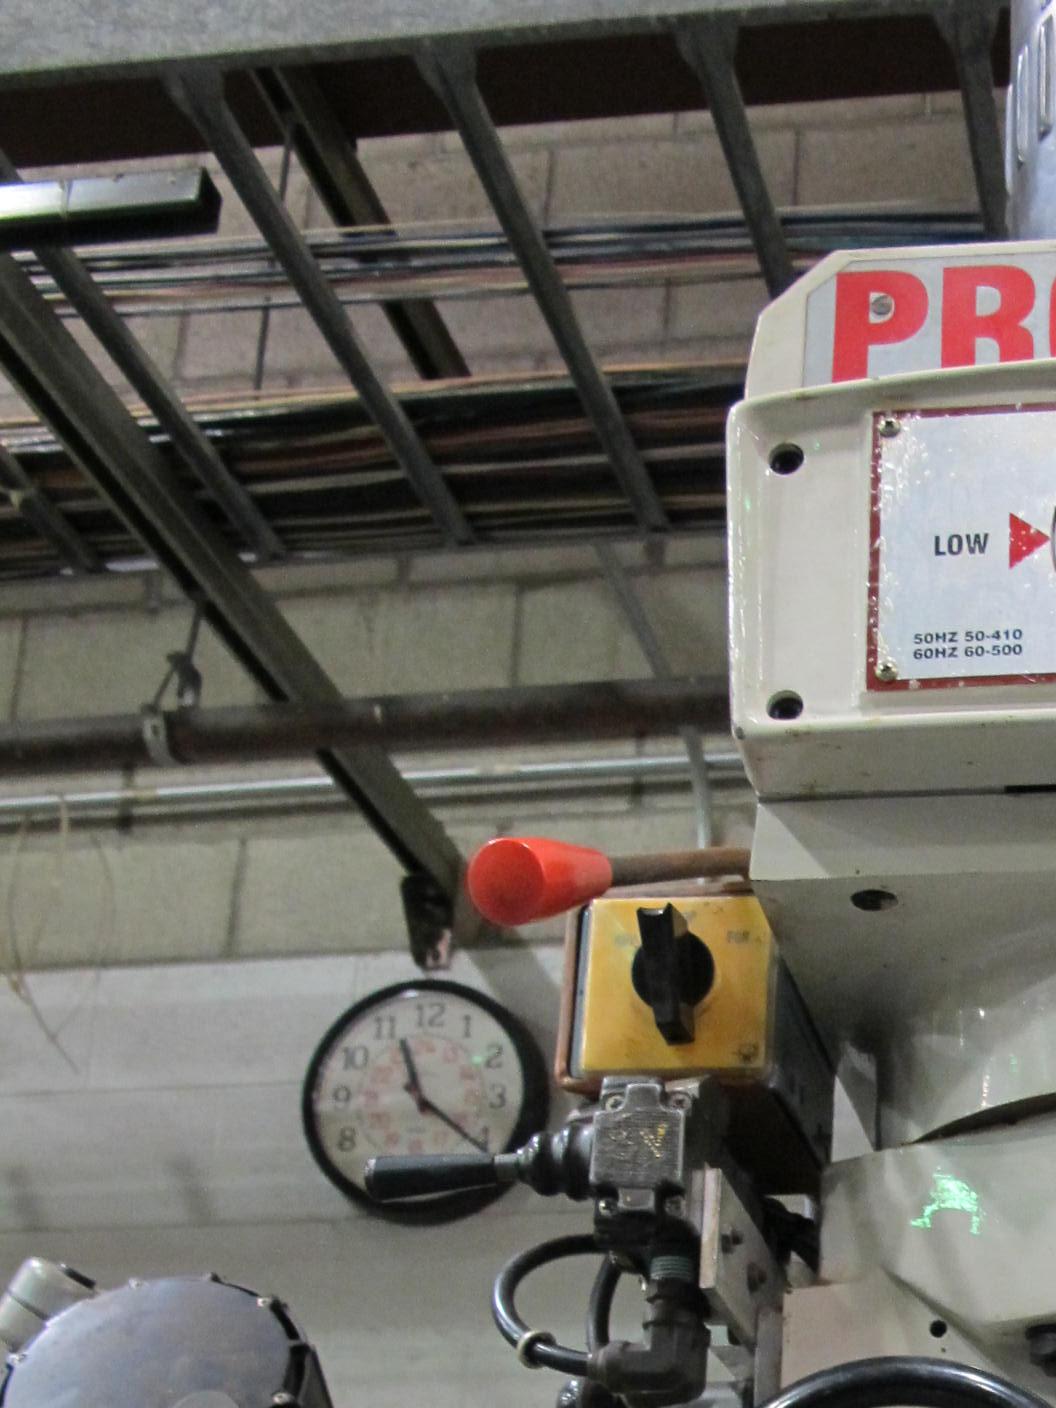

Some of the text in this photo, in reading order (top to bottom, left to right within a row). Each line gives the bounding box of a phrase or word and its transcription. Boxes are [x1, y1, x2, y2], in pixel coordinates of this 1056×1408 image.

[934, 533, 989, 556] LOW
[914, 628, 1023, 645] 50HZ 50-410
[913, 643, 1023, 660] 60HZ 60-500
[373, 1015, 396, 1041] 11
[415, 1002, 446, 1028] 12
[462, 1014, 472, 1039] 1
[343, 1045, 369, 1071] 10
[484, 1044, 504, 1069] 2
[333, 1085, 351, 1111] 9
[489, 1083, 507, 1109] 3
[337, 1126, 357, 1152] 8
